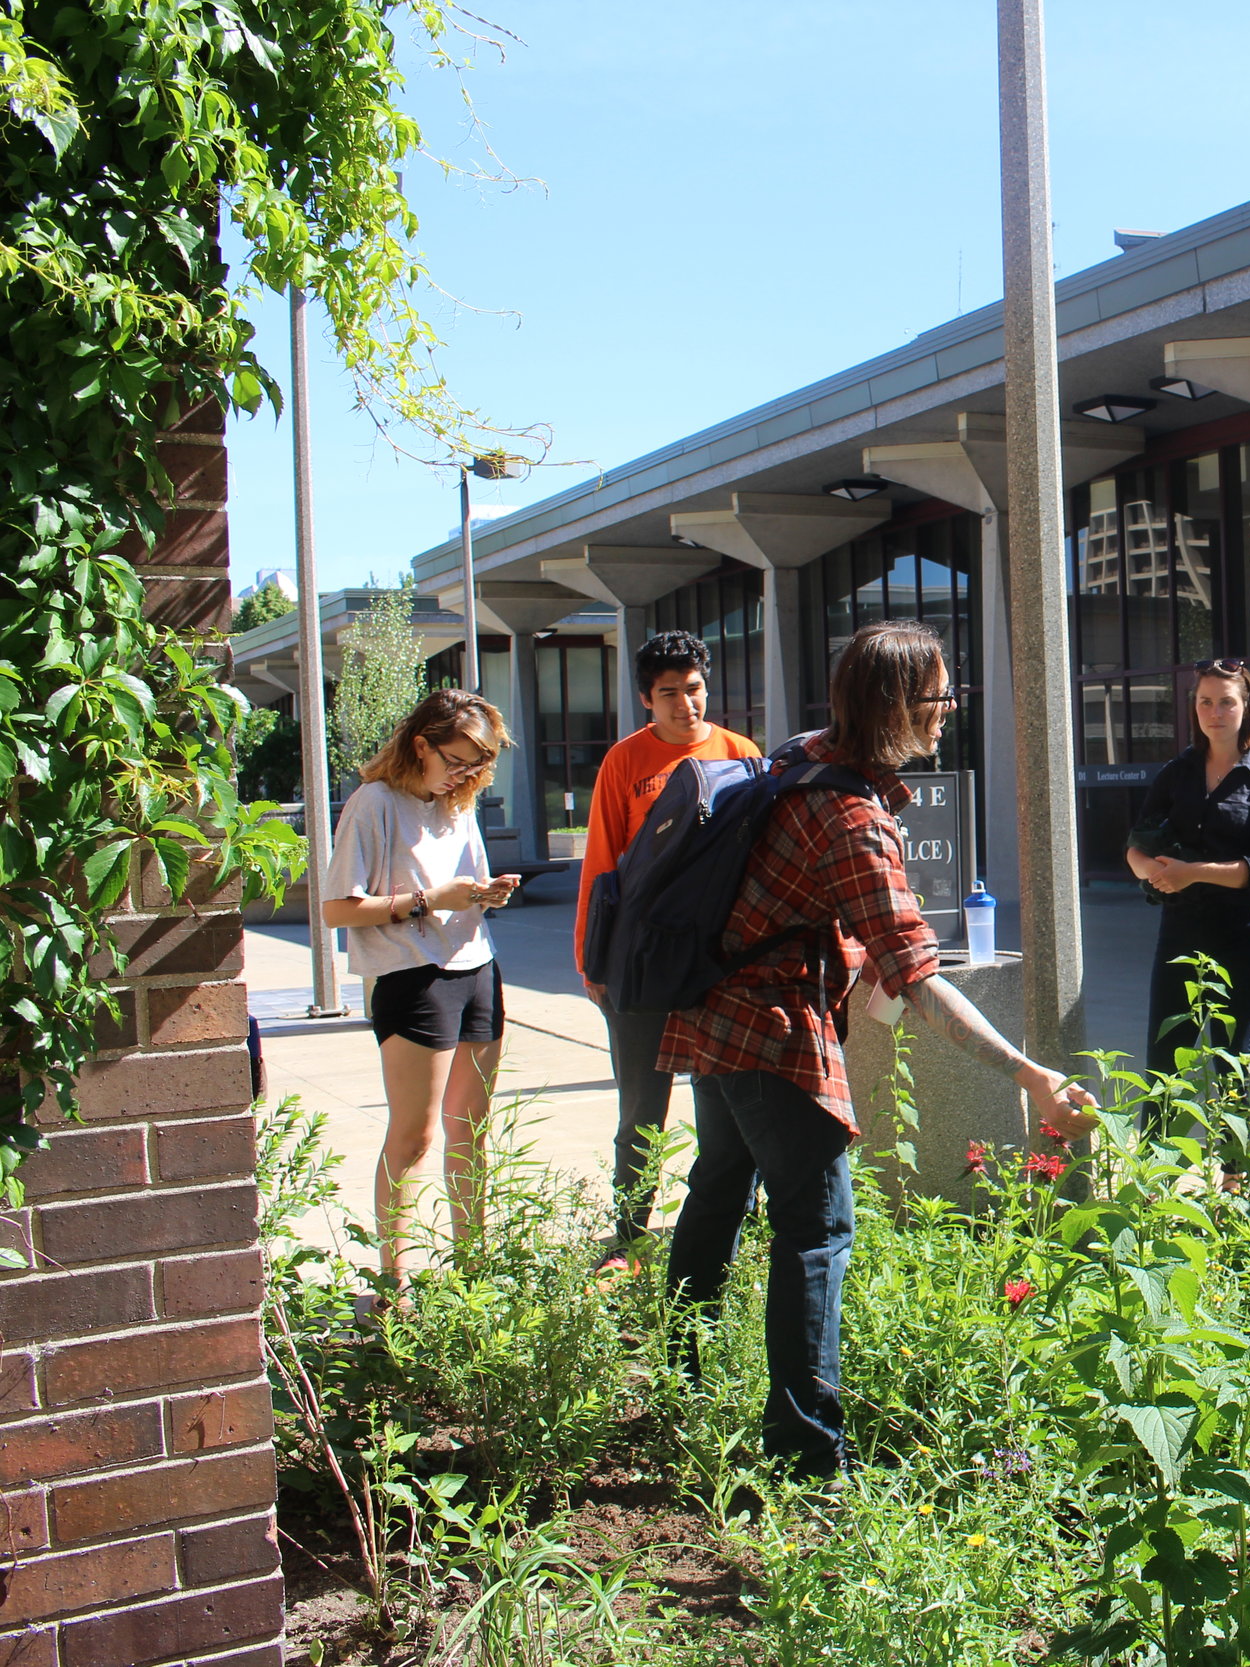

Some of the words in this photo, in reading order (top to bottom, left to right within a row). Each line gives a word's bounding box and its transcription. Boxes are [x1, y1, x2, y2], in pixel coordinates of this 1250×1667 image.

[1097, 770, 1118, 781] Lecture
[1119, 770, 1139, 780] Center
[1140, 769, 1146, 779] D
[929, 786, 946, 806] E
